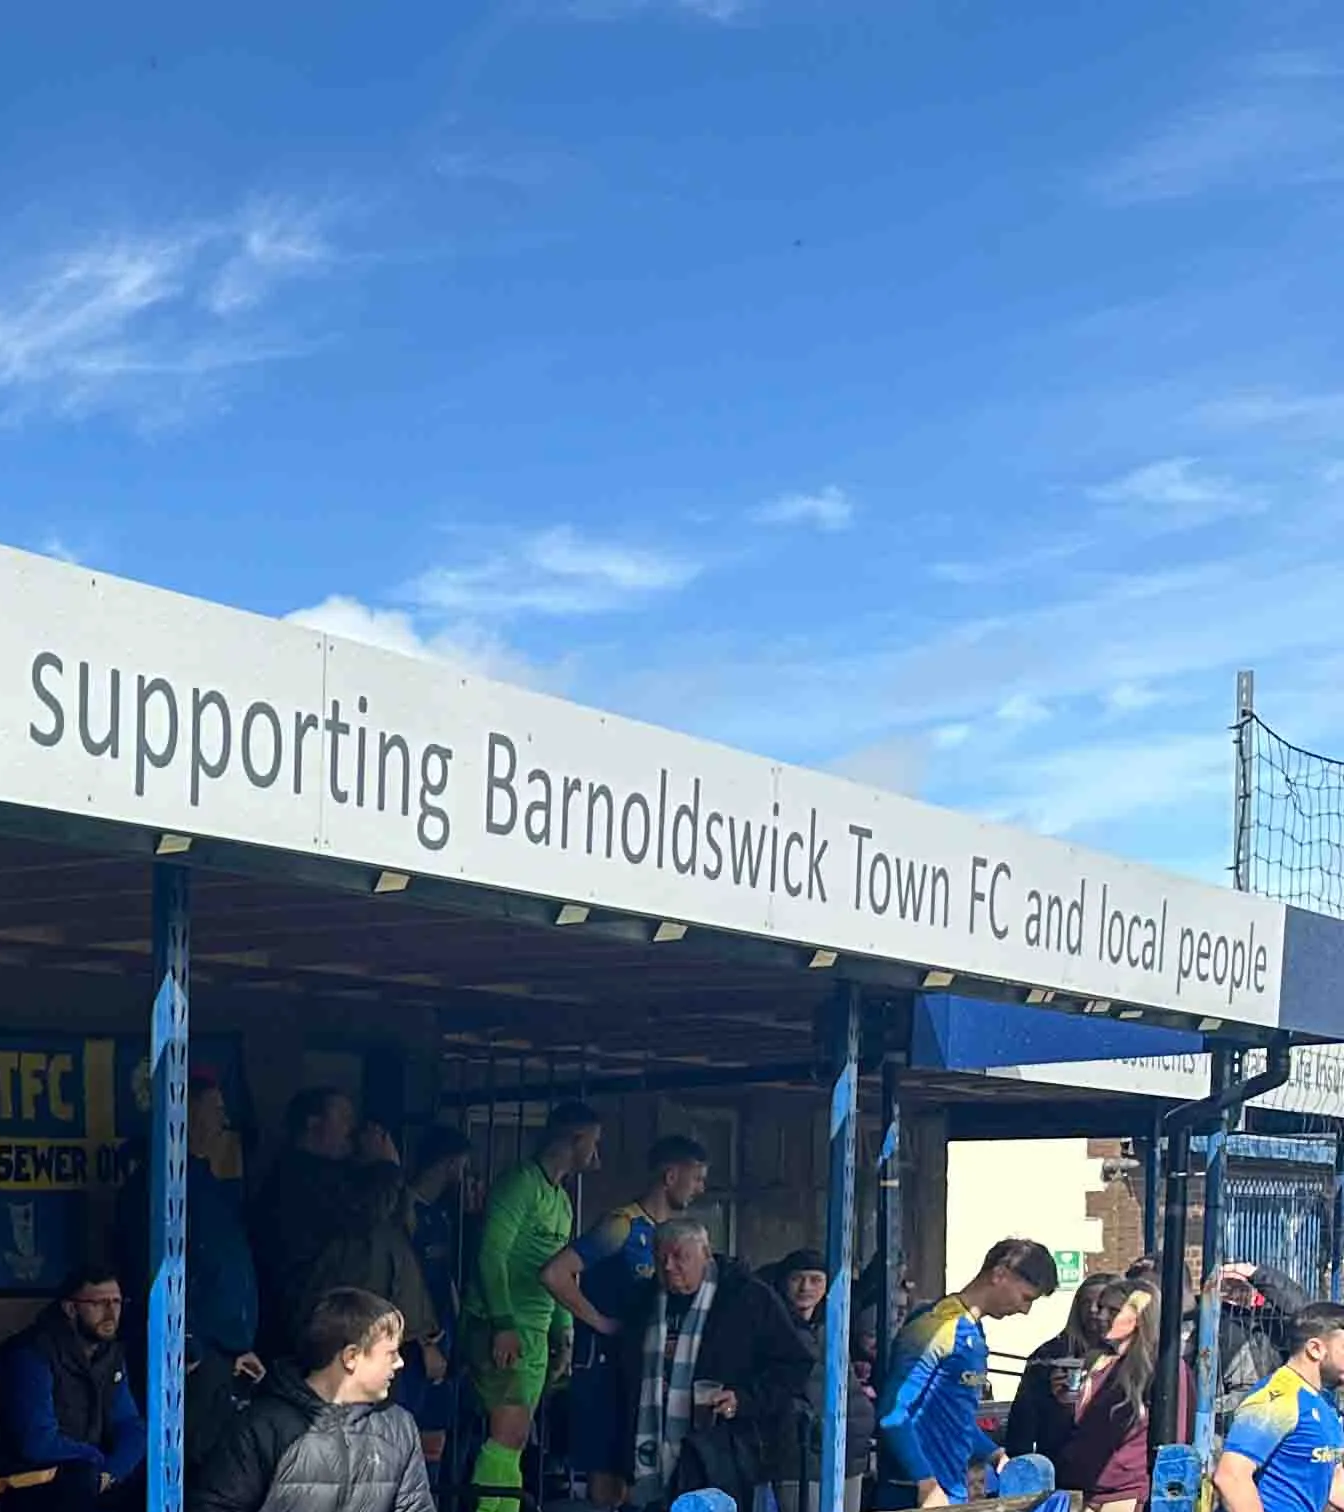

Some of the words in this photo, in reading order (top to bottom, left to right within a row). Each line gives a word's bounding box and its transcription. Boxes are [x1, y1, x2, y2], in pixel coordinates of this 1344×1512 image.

[30, 651, 452, 851] supporting
[488, 732, 829, 903] Barnoldswick
[848, 825, 950, 930] Town
[970, 856, 1012, 941] FC
[1026, 879, 1083, 957] and
[1099, 884, 1166, 976] local
[1177, 922, 1268, 1004] people
